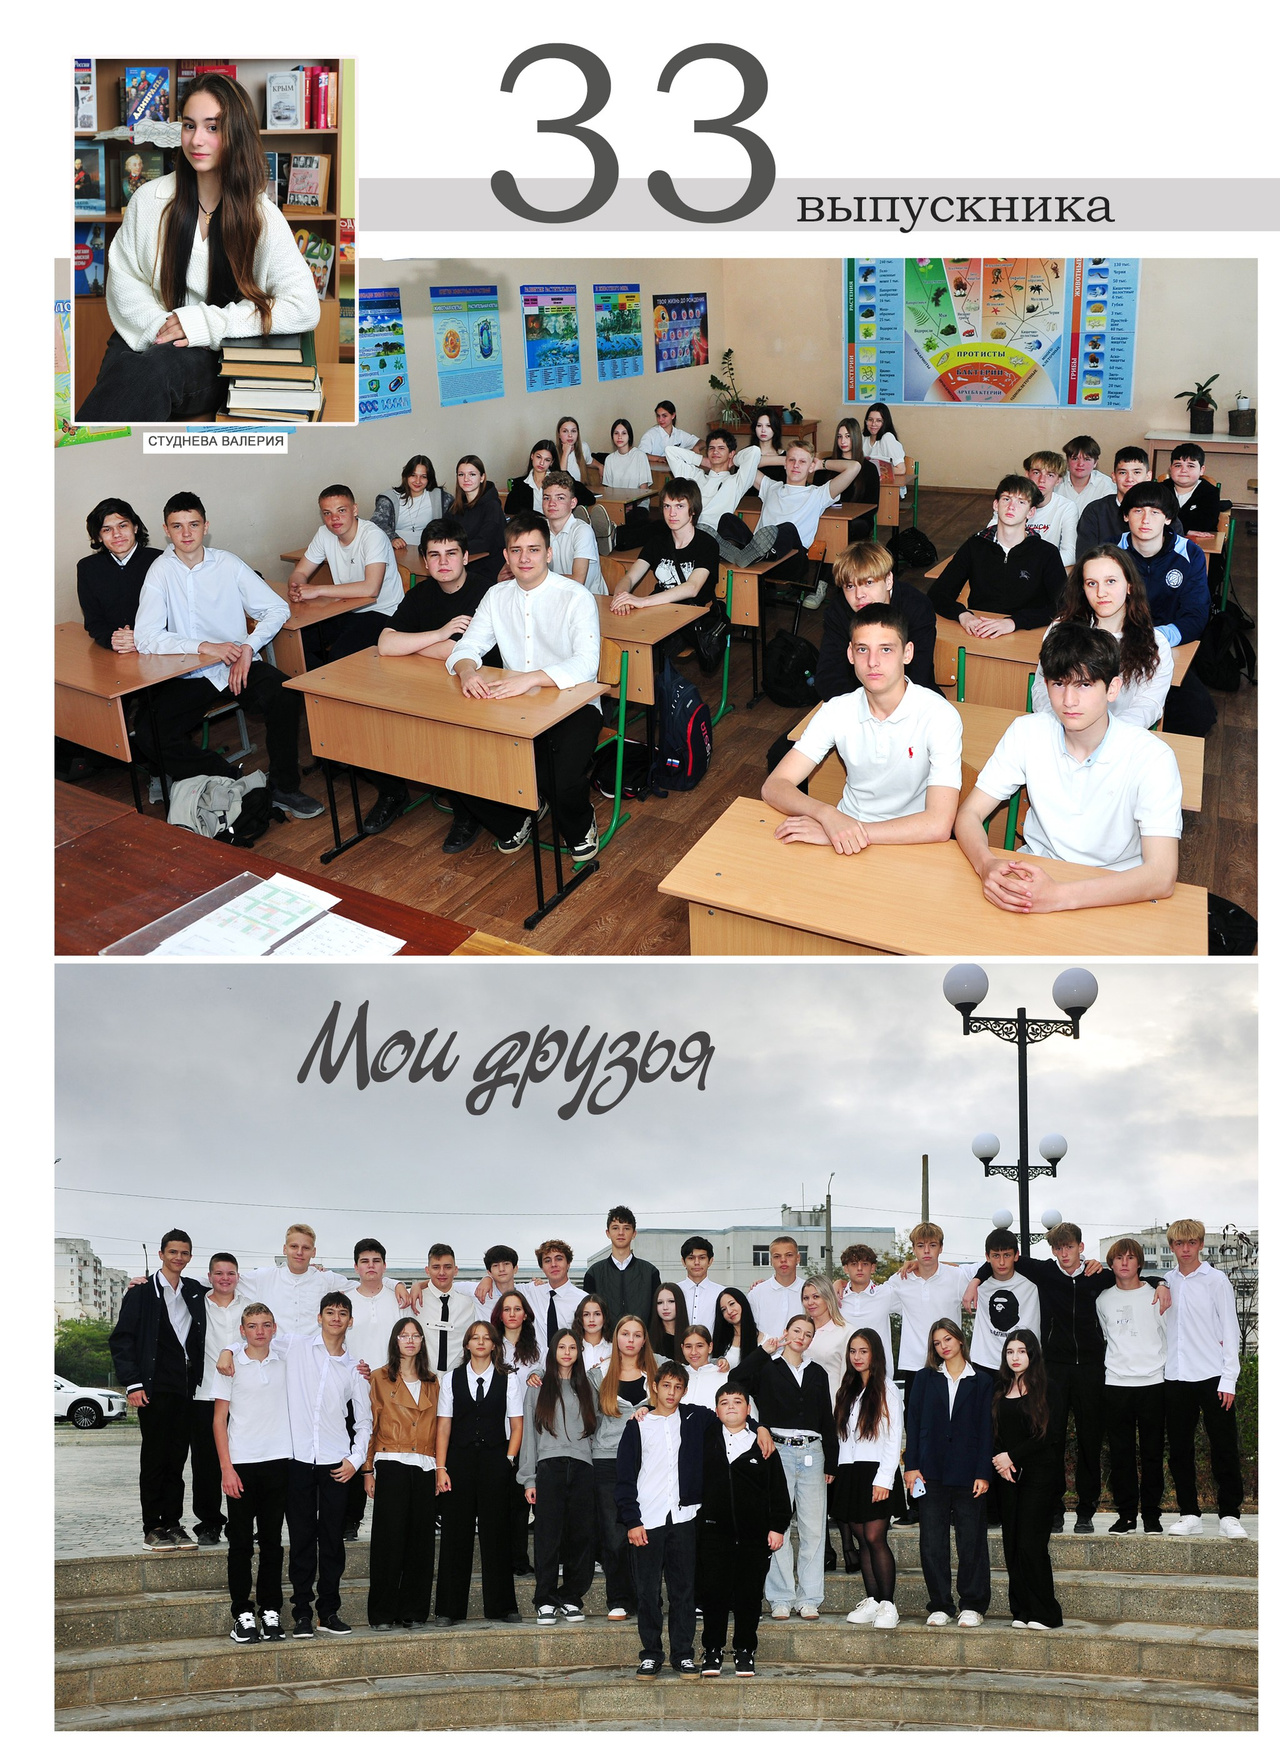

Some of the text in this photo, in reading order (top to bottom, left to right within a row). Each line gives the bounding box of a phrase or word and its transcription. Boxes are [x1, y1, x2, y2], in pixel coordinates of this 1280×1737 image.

[132, 75, 165, 121] АДМИРАЛЫ
[272, 84, 294, 93] КРЫМ
[1074, 258, 1083, 297] ЖИВОТНЫ
